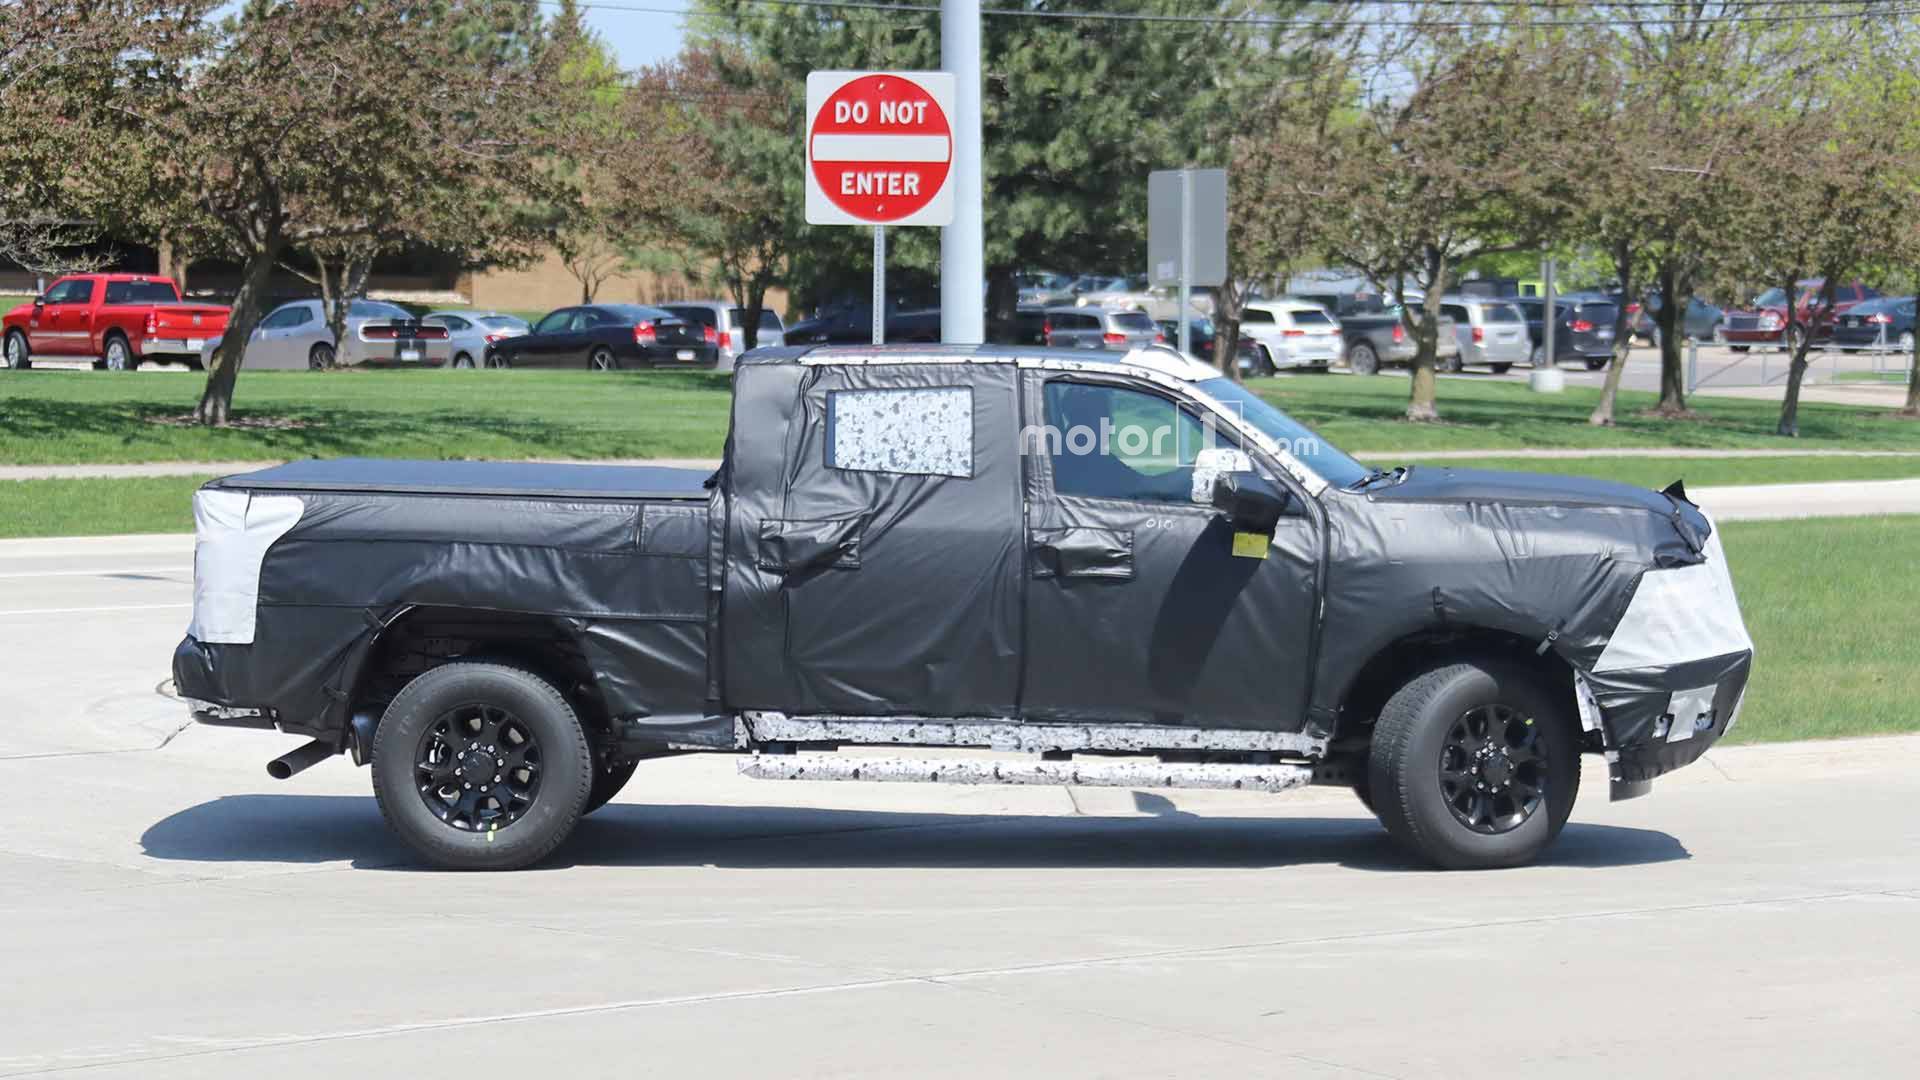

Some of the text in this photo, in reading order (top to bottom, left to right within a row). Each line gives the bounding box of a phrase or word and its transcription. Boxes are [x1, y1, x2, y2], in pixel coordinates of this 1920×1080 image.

[834, 100, 927, 124] DO NOT
[840, 171, 920, 196] ENTER
